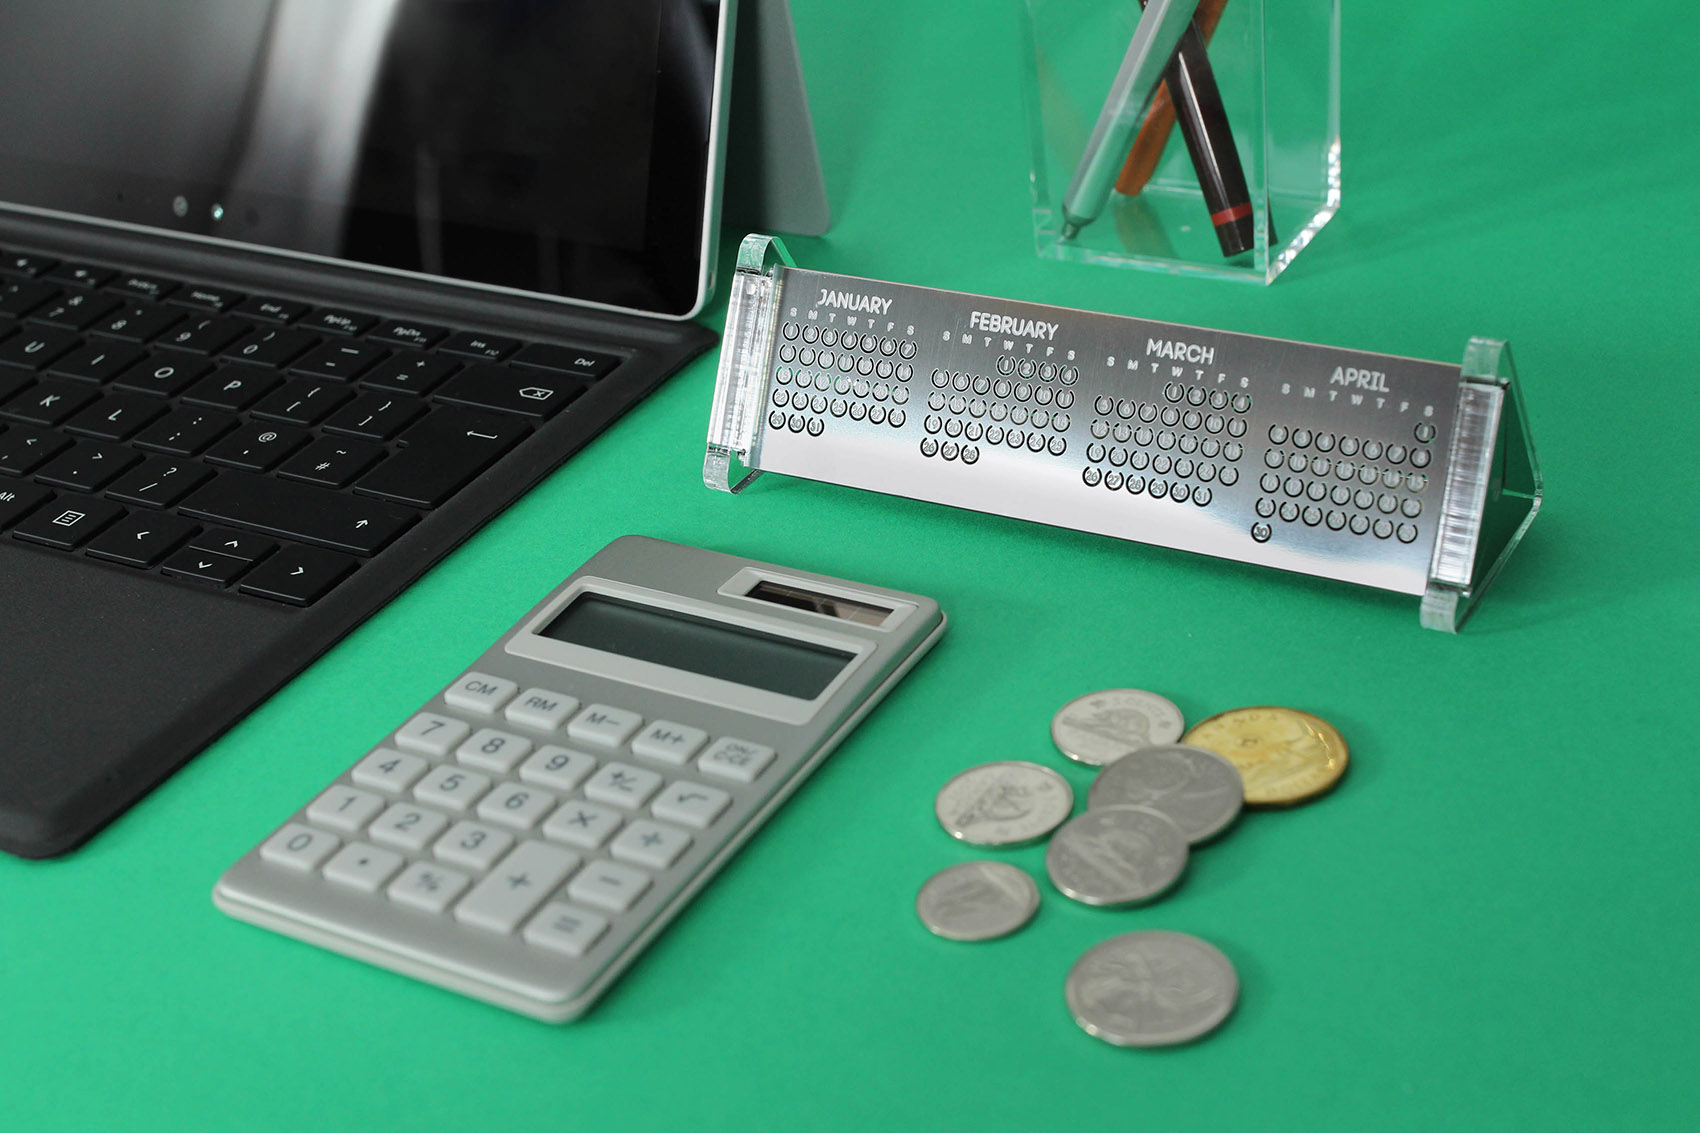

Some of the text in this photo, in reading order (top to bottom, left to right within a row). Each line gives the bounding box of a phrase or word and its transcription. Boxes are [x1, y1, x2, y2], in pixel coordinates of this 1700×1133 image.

[817, 289, 892, 315] JANUARY
[790, 307, 914, 335] S M T W T F S
[970, 311, 1059, 340] FEBRUARY
[25, 342, 44, 352] U
[943, 331, 1075, 360] S M T W T F S
[1146, 338, 1214, 365] MARCH
[92, 355, 104, 364] I
[155, 368, 174, 378] O
[1107, 356, 1249, 388] S M T W T F S
[1330, 366, 1389, 392] APRIL
[224, 381, 241, 390] P
[40, 396, 59, 406] K
[1282, 383, 1290, 394] S
[1304, 387, 1315, 397] M
[1329, 391, 1337, 401] T
[1351, 394, 1363, 405] W
[1376, 398, 1385, 408] T
[1400, 402, 1409, 412] F
[109, 409, 121, 420] L
[259, 432, 277, 442] @
[164, 468, 176, 476] ?
[466, 681, 498, 695] CM
[526, 697, 557, 711] RM
[422, 721, 445, 735] 7
[651, 729, 682, 743] M+
[482, 738, 505, 753] 8
[379, 760, 400, 773] 4
[546, 755, 569, 770] 9
[440, 775, 464, 790] 5
[340, 797, 356, 811] 1
[505, 794, 529, 808] 6
[395, 813, 420, 830] 2
[287, 834, 313, 851] 0
[461, 832, 486, 848] 3
